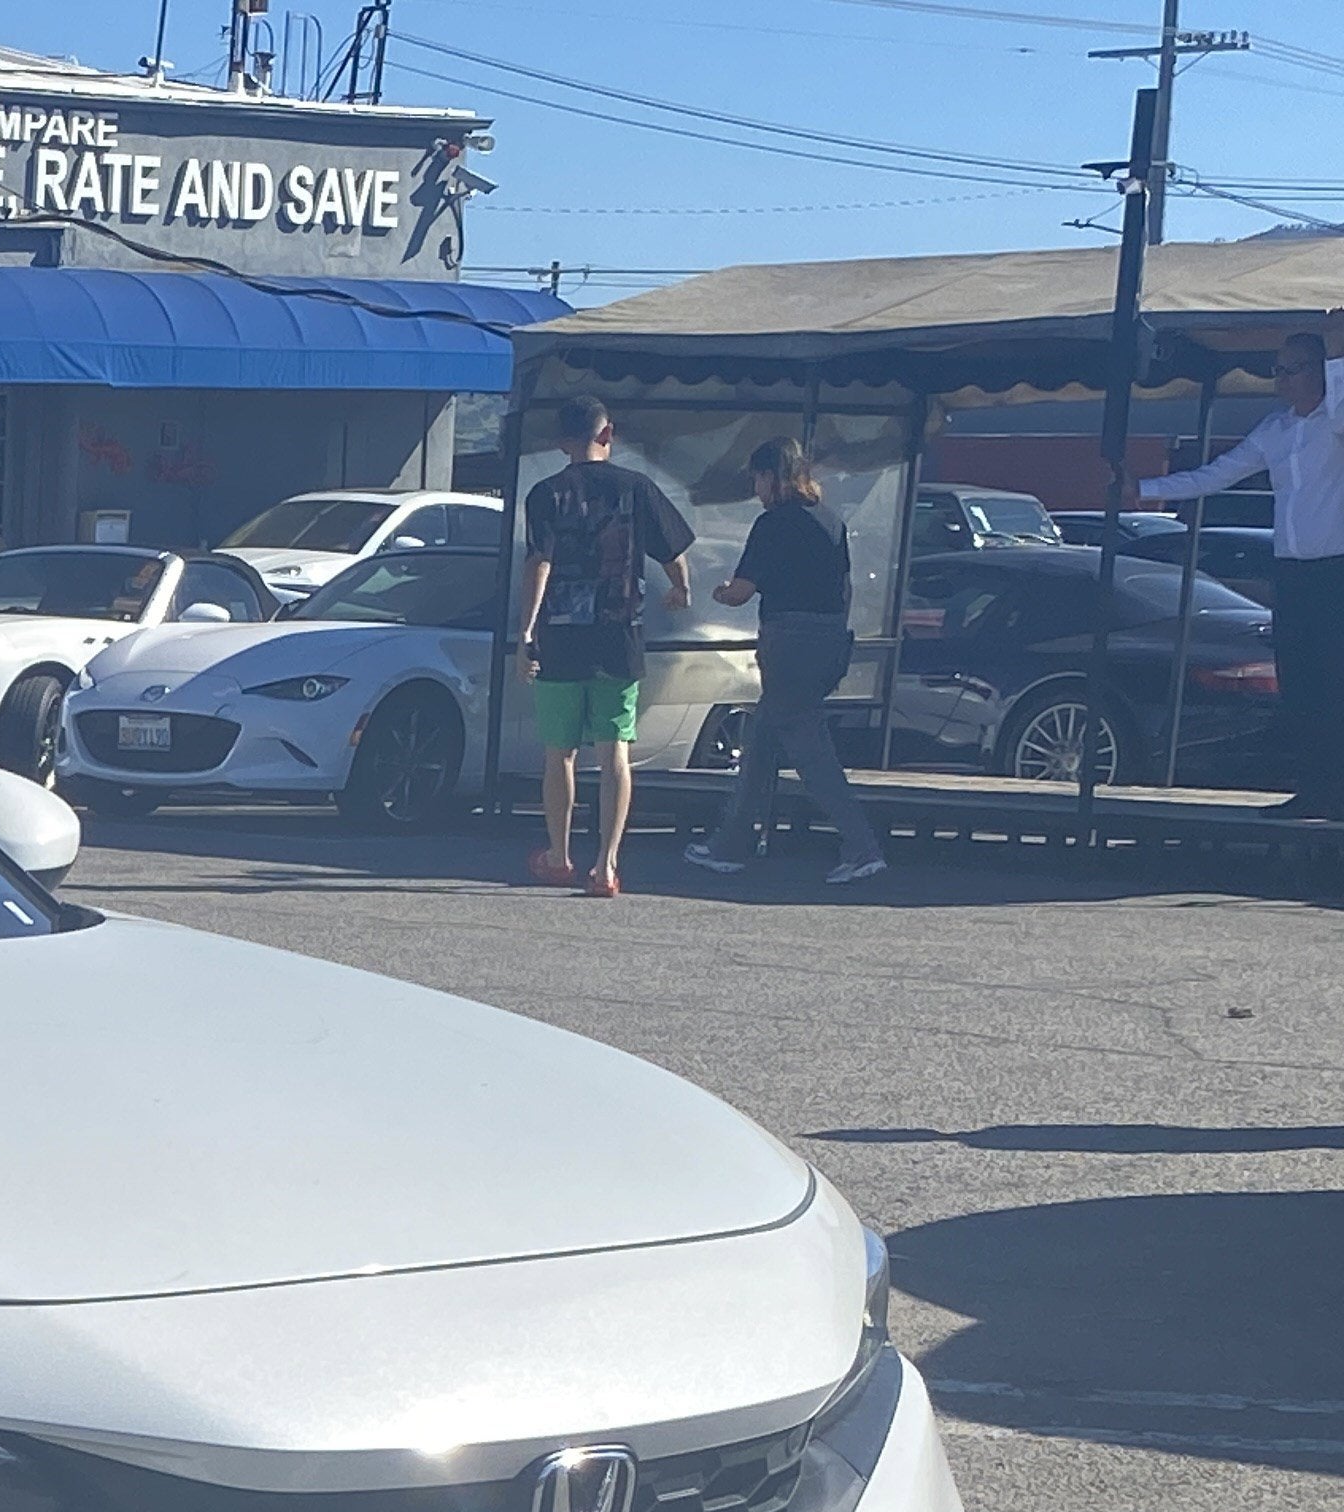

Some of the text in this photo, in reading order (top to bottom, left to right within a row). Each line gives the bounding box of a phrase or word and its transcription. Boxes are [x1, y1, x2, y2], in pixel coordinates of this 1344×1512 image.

[36, 147, 161, 215] RATE
[174, 158, 273, 221] AND
[287, 165, 399, 228] SAVE
